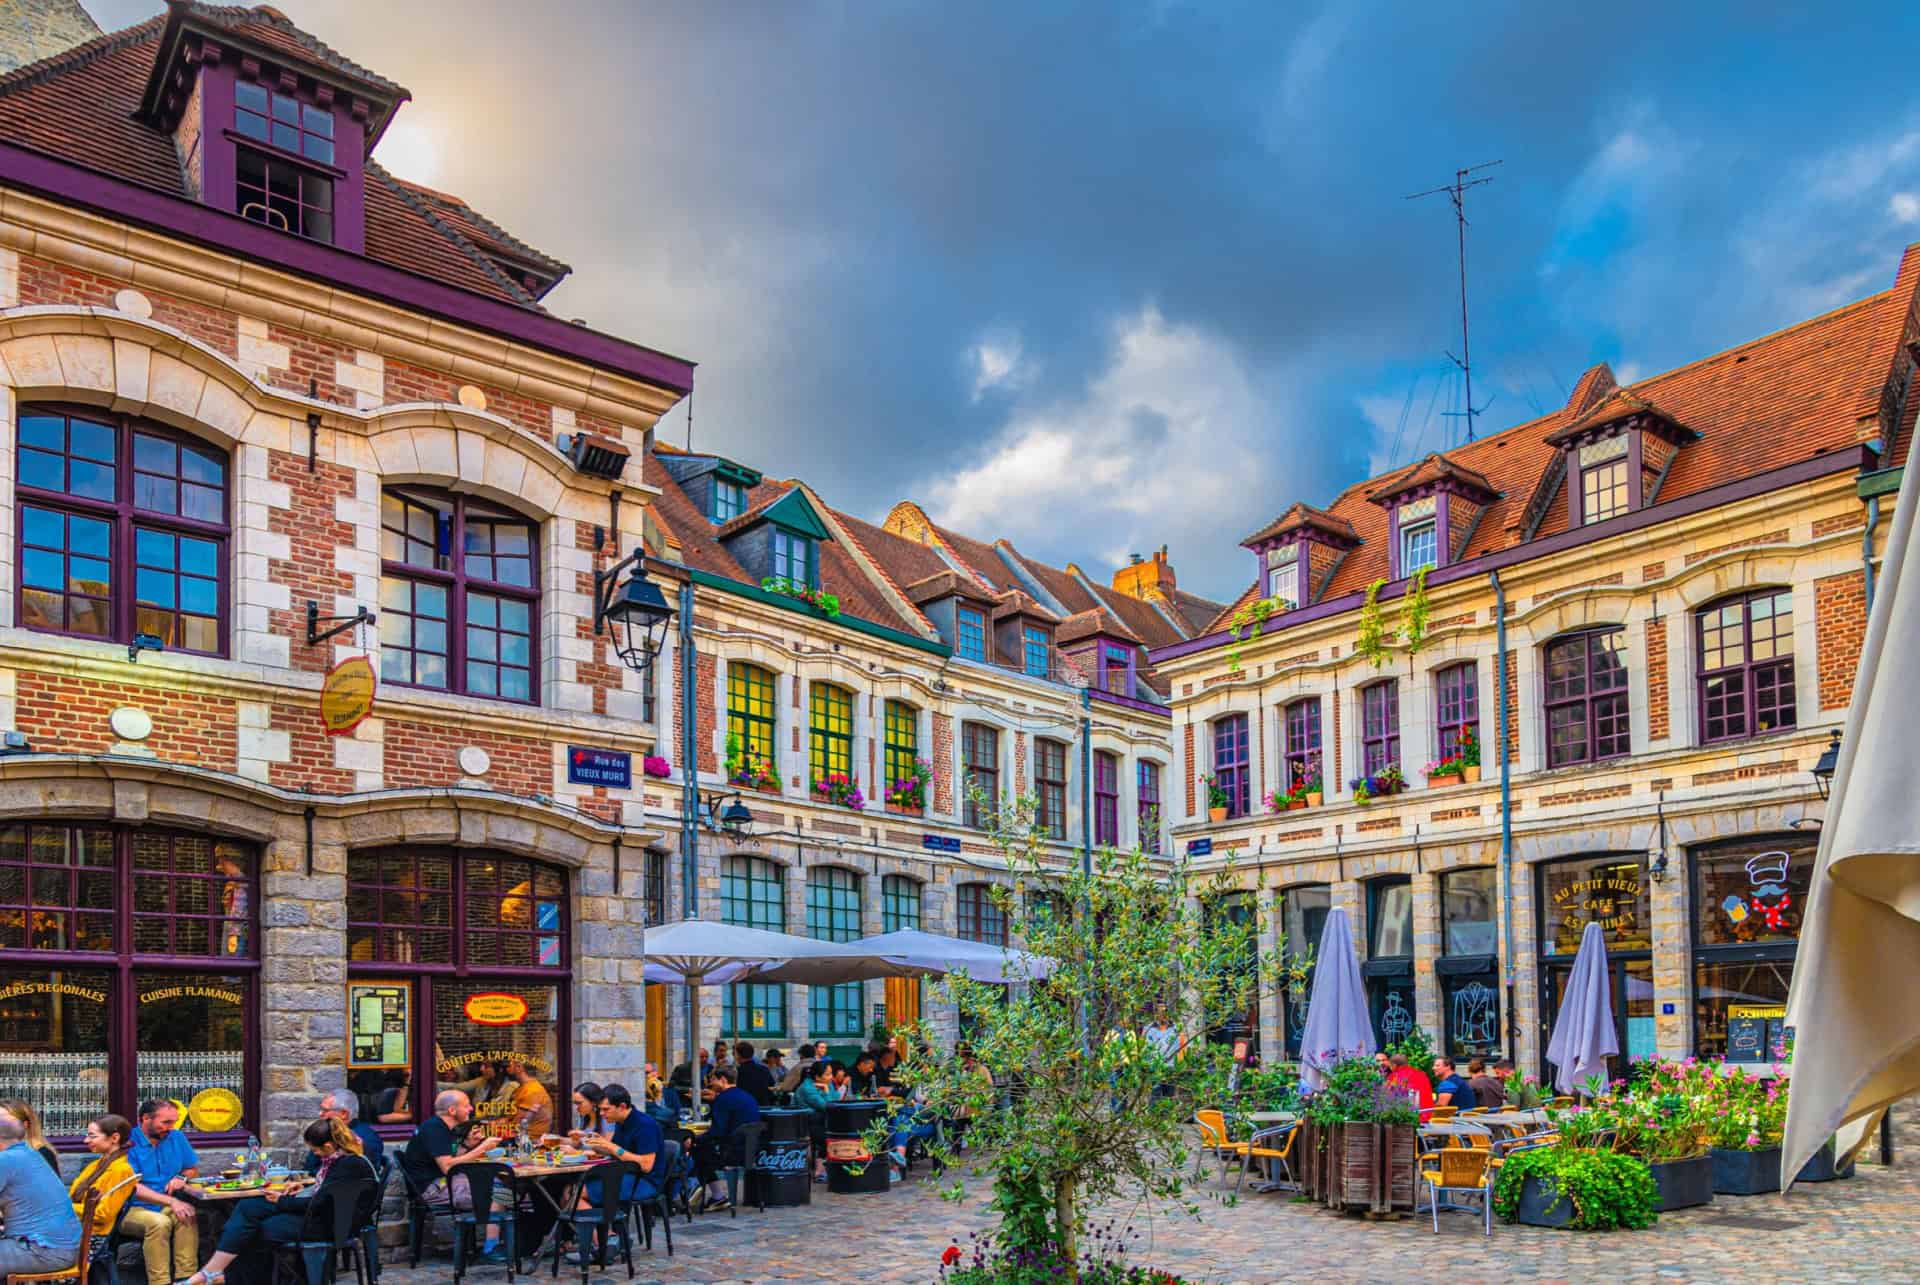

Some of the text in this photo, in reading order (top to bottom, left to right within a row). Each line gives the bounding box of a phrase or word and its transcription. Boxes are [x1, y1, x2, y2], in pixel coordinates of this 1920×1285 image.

[576, 768, 625, 782] VIEUX MURS
[1553, 880, 1645, 903] AU PETIT VIEUX
[140, 986, 242, 1005] CUISINE FLAMANDE
